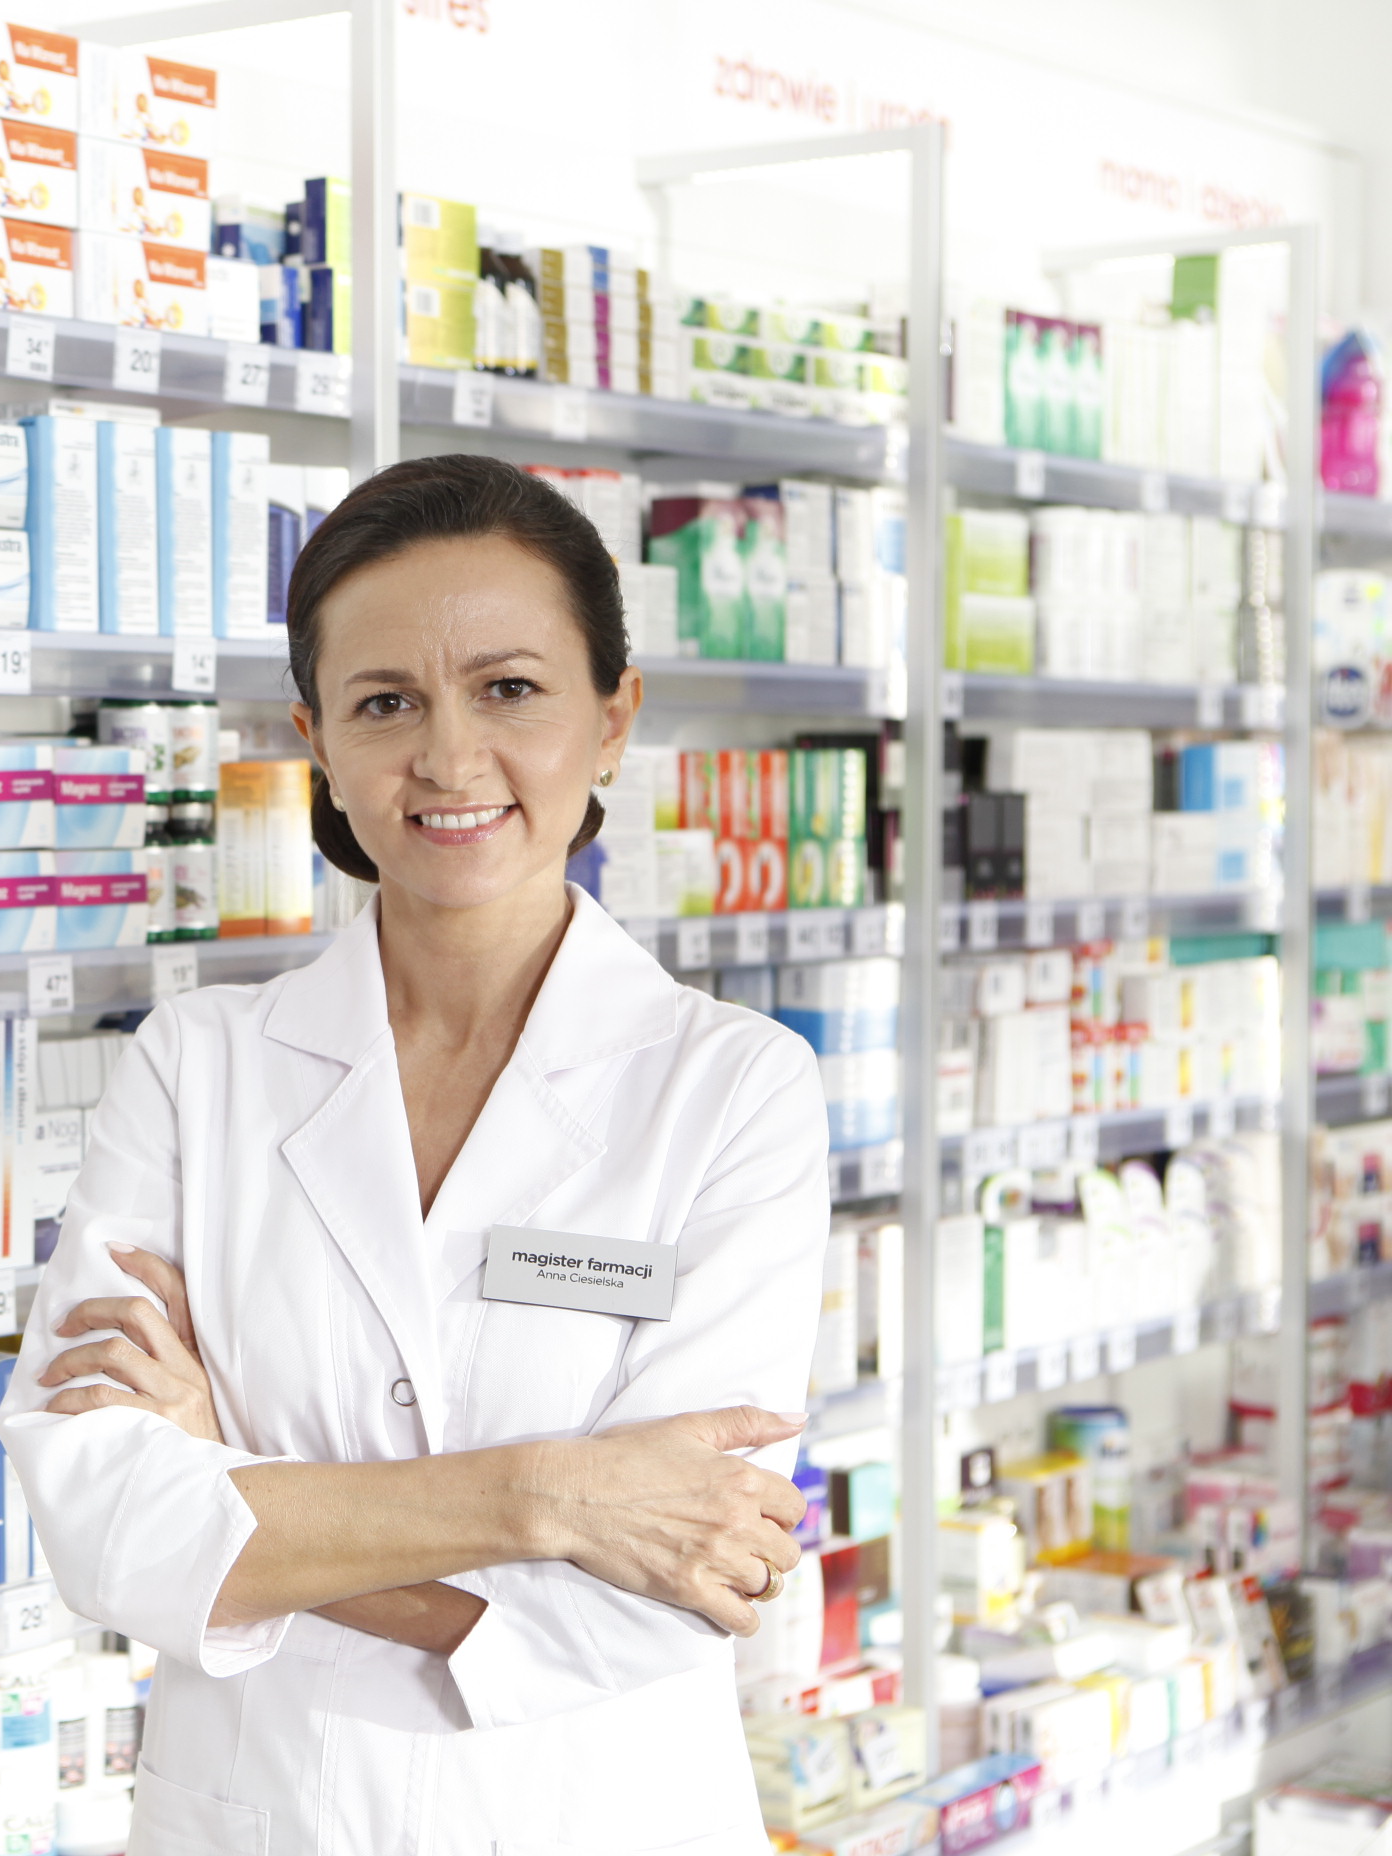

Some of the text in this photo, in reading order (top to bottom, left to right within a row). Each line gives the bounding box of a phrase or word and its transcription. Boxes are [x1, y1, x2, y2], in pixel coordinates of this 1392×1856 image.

[0, 652, 22, 674] 19
[61, 780, 101, 798] Magnez
[61, 882, 102, 900] Magnez
[512, 1250, 653, 1278] magister farmacji
[536, 1269, 624, 1288] Anna Ciesielska
